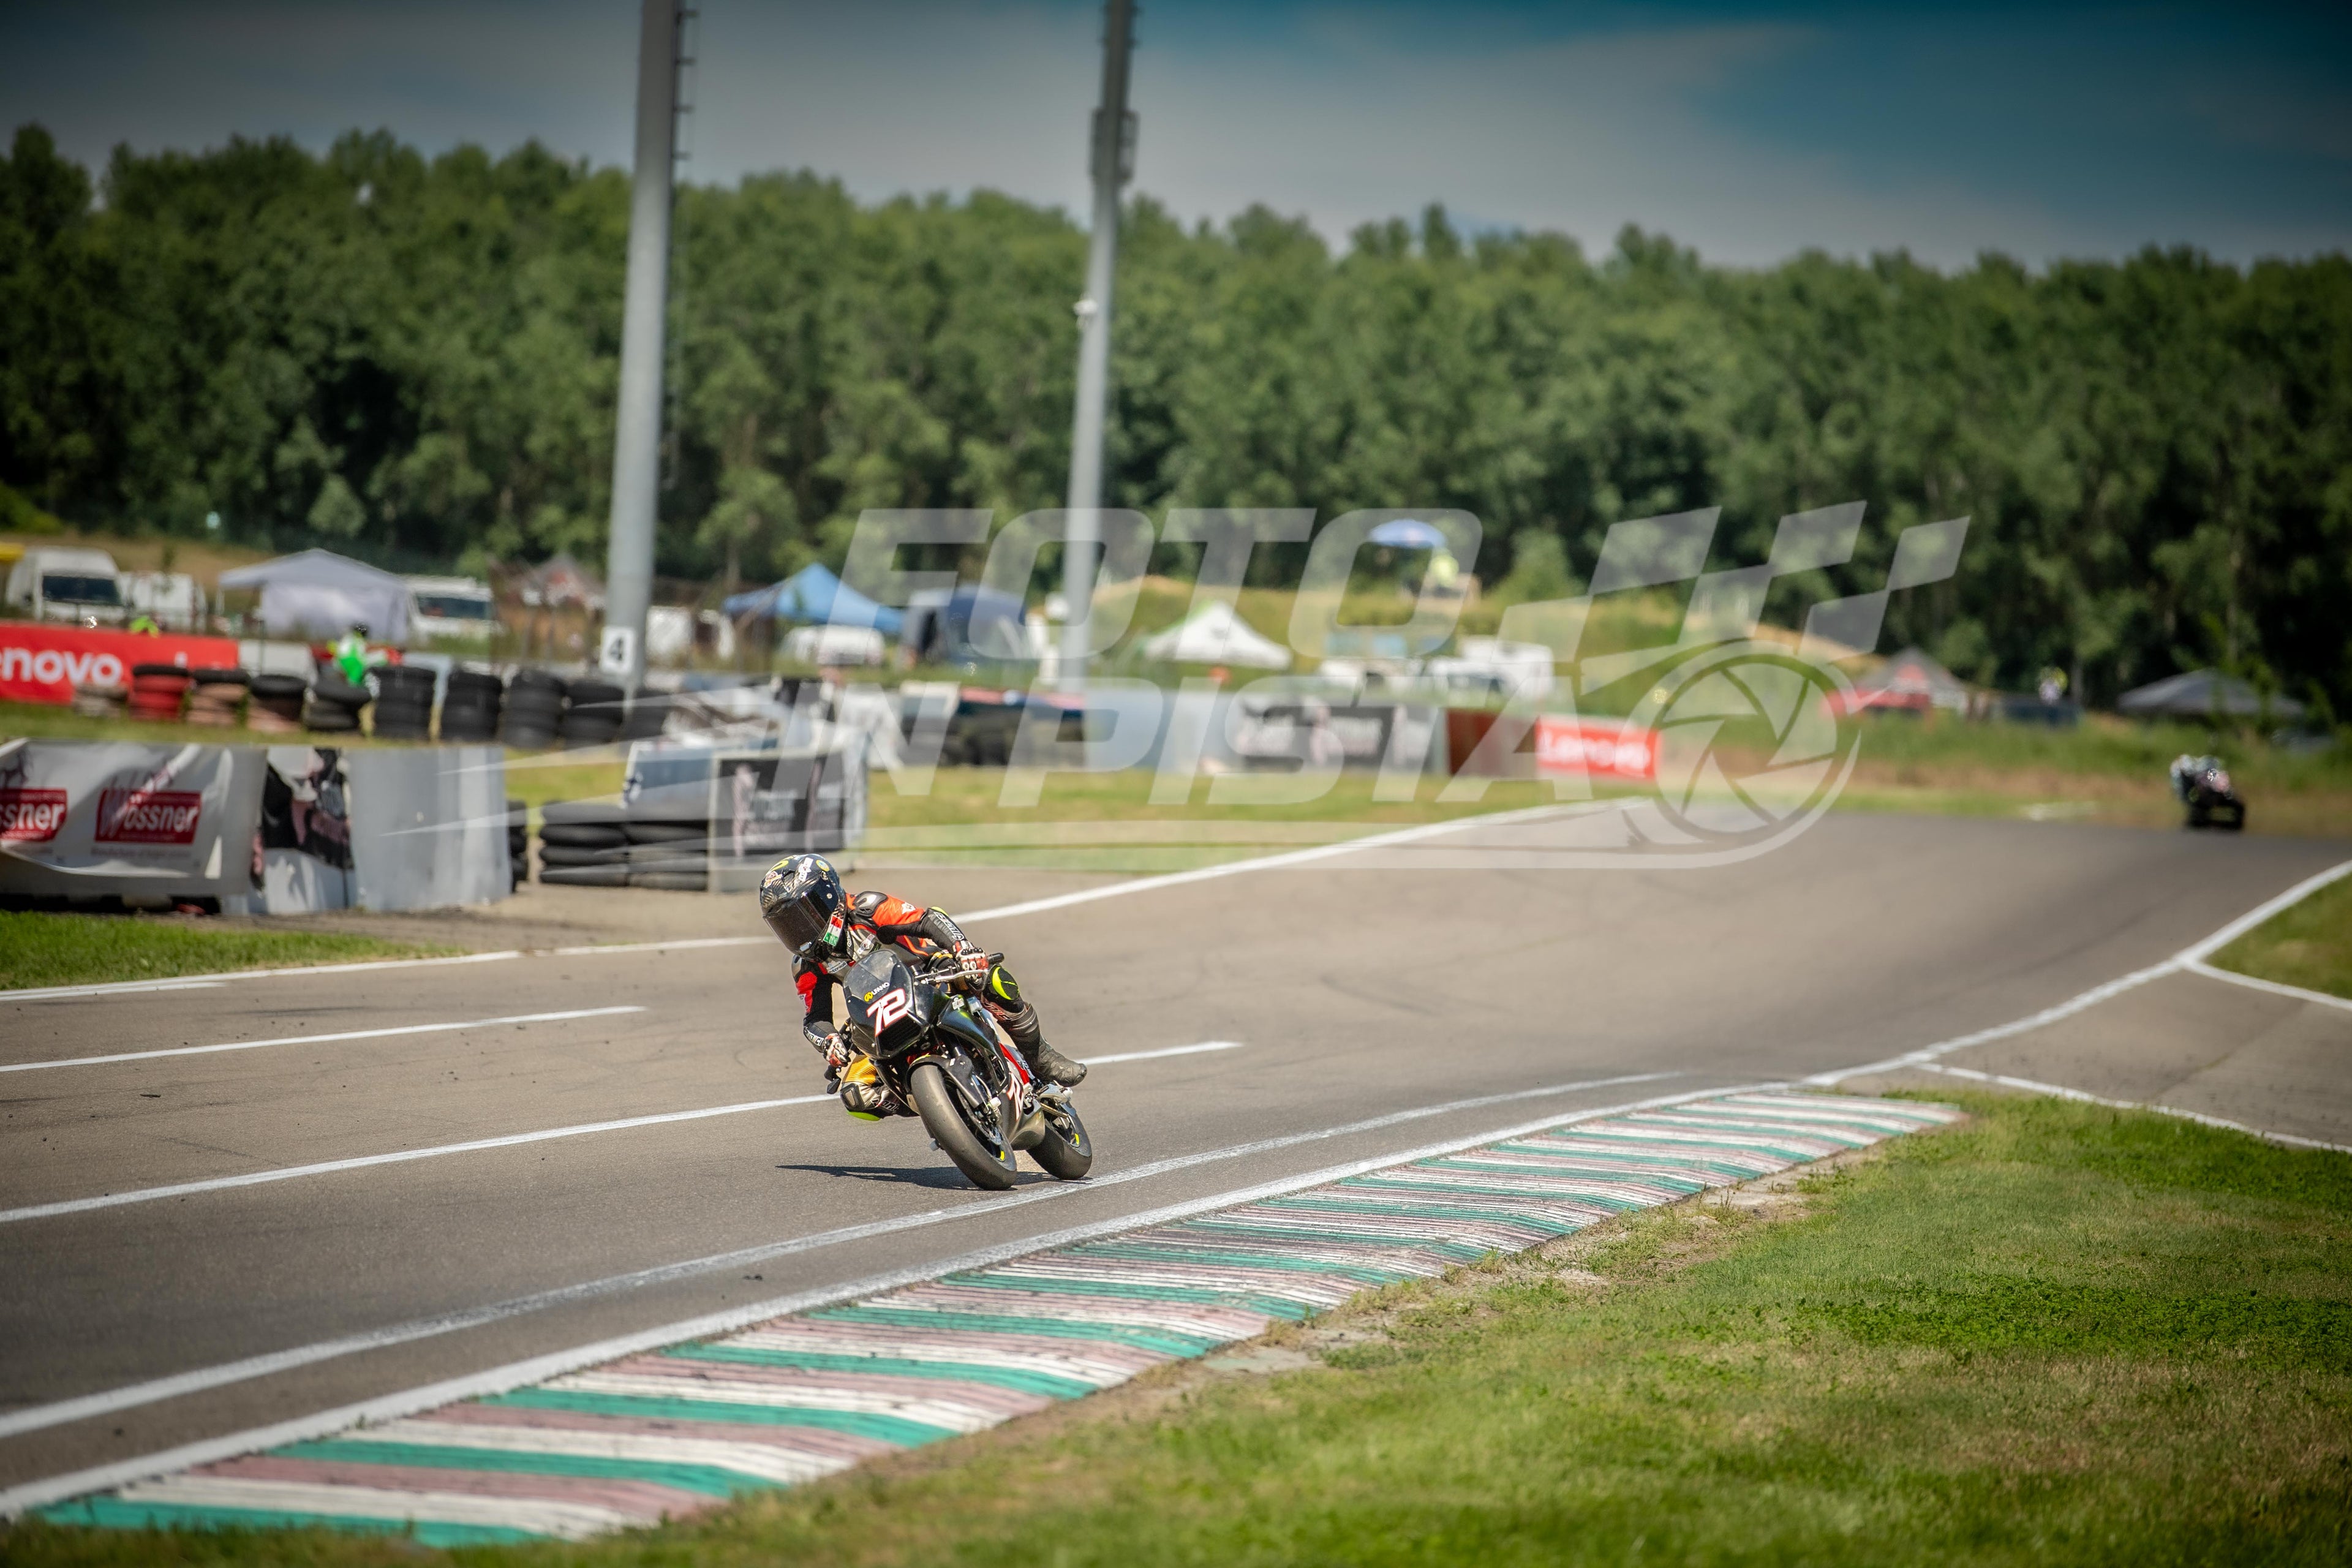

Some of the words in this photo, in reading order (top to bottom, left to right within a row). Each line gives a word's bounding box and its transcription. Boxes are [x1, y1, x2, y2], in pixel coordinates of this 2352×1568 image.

[0, 646, 123, 687] novo
[608, 636, 624, 662] 4
[865, 987, 908, 1038] 72
